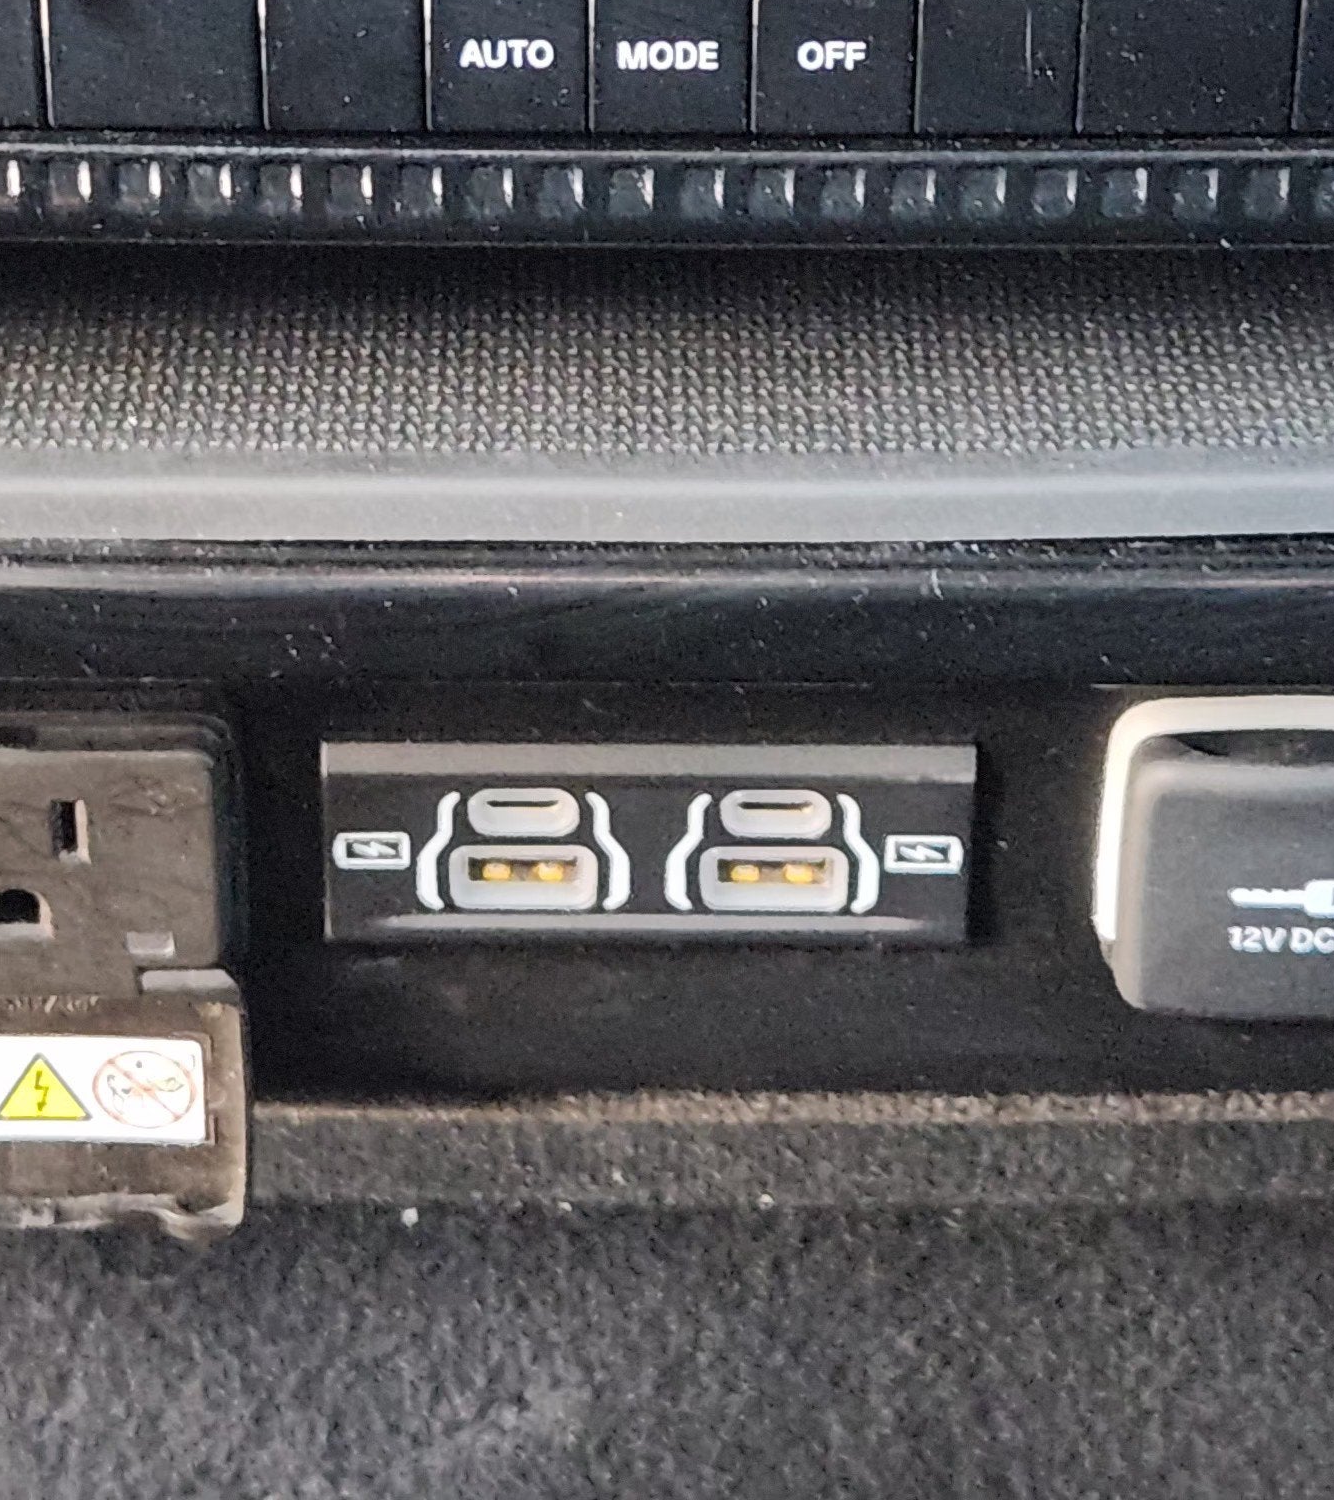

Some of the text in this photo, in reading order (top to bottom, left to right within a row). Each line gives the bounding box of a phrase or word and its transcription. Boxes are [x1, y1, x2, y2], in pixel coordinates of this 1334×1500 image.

[459, 38, 555, 69] AUTO
[616, 40, 719, 71] MODE
[797, 40, 867, 71] OFF
